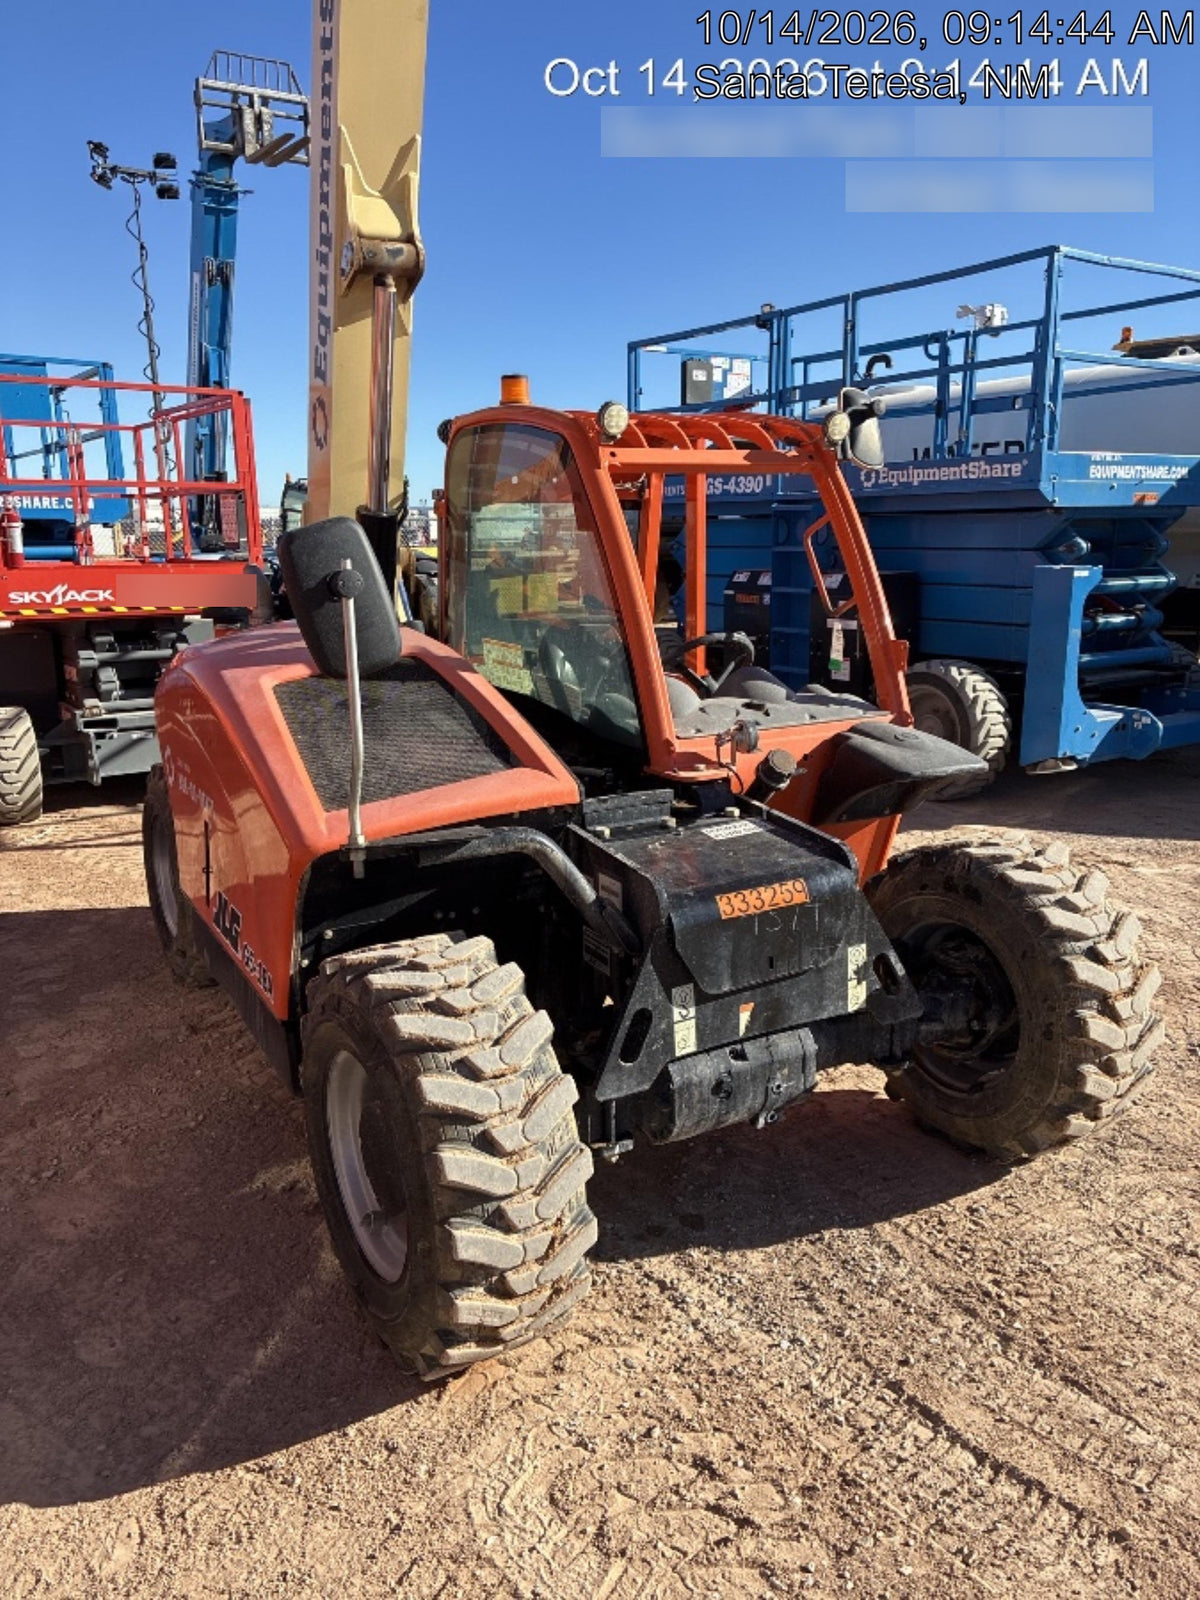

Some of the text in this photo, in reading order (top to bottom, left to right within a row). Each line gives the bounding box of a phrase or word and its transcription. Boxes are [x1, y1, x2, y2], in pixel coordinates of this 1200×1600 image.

[878, 460, 1022, 487] EquipmentShare
[8, 583, 116, 605] SKYJACK
[719, 879, 809, 917] 333259
